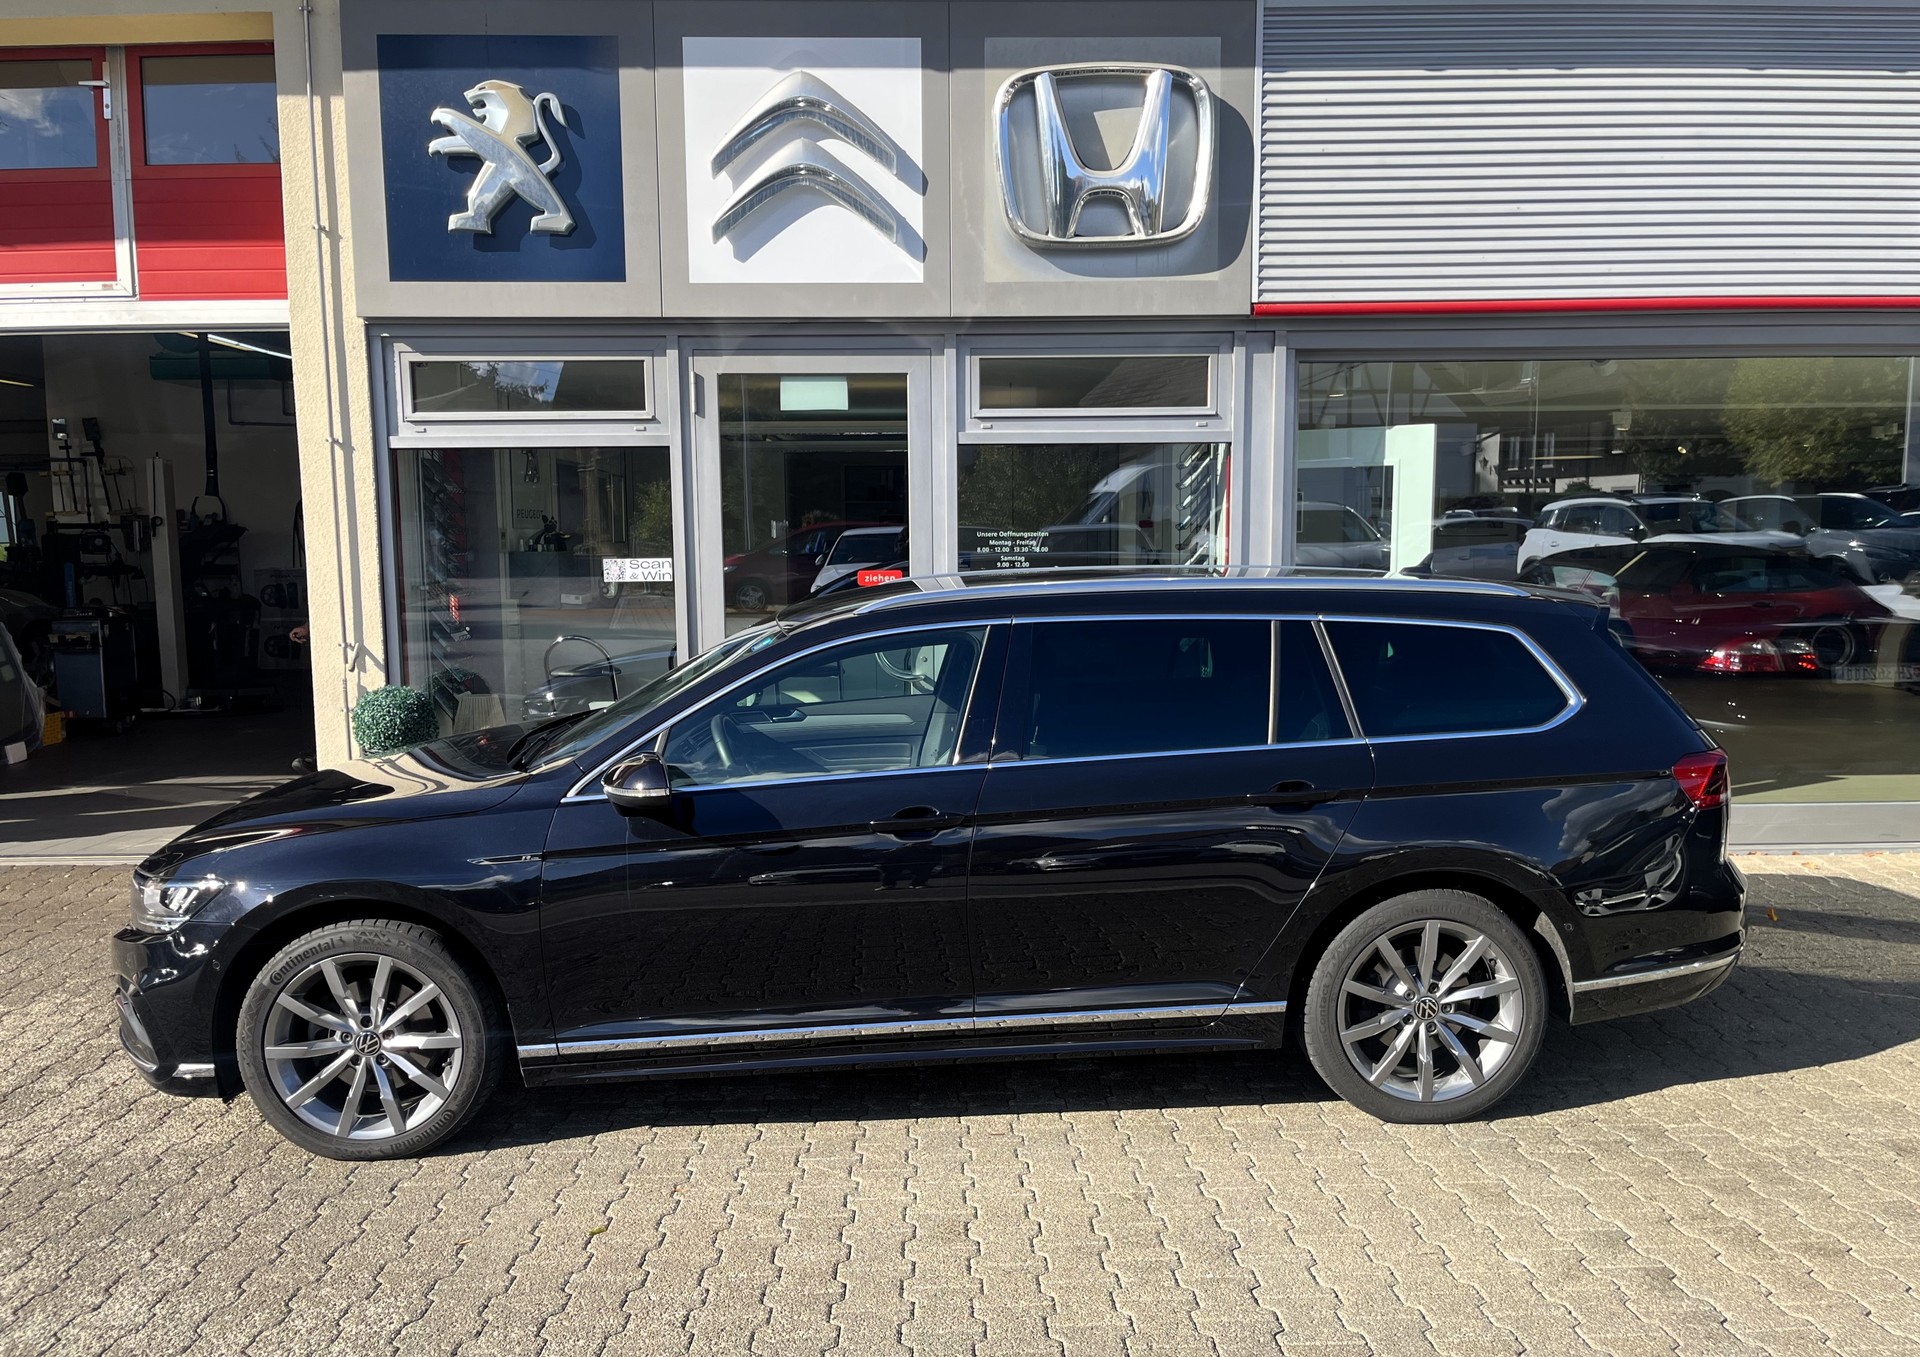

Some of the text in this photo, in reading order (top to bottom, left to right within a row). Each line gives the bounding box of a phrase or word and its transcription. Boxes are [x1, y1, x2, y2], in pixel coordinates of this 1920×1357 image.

[629, 559, 673, 570] Scan
[629, 570, 673, 581] & Win
[864, 574, 896, 582] ziehen
[269, 936, 336, 986] Continental
[390, 1108, 456, 1155] Continental
